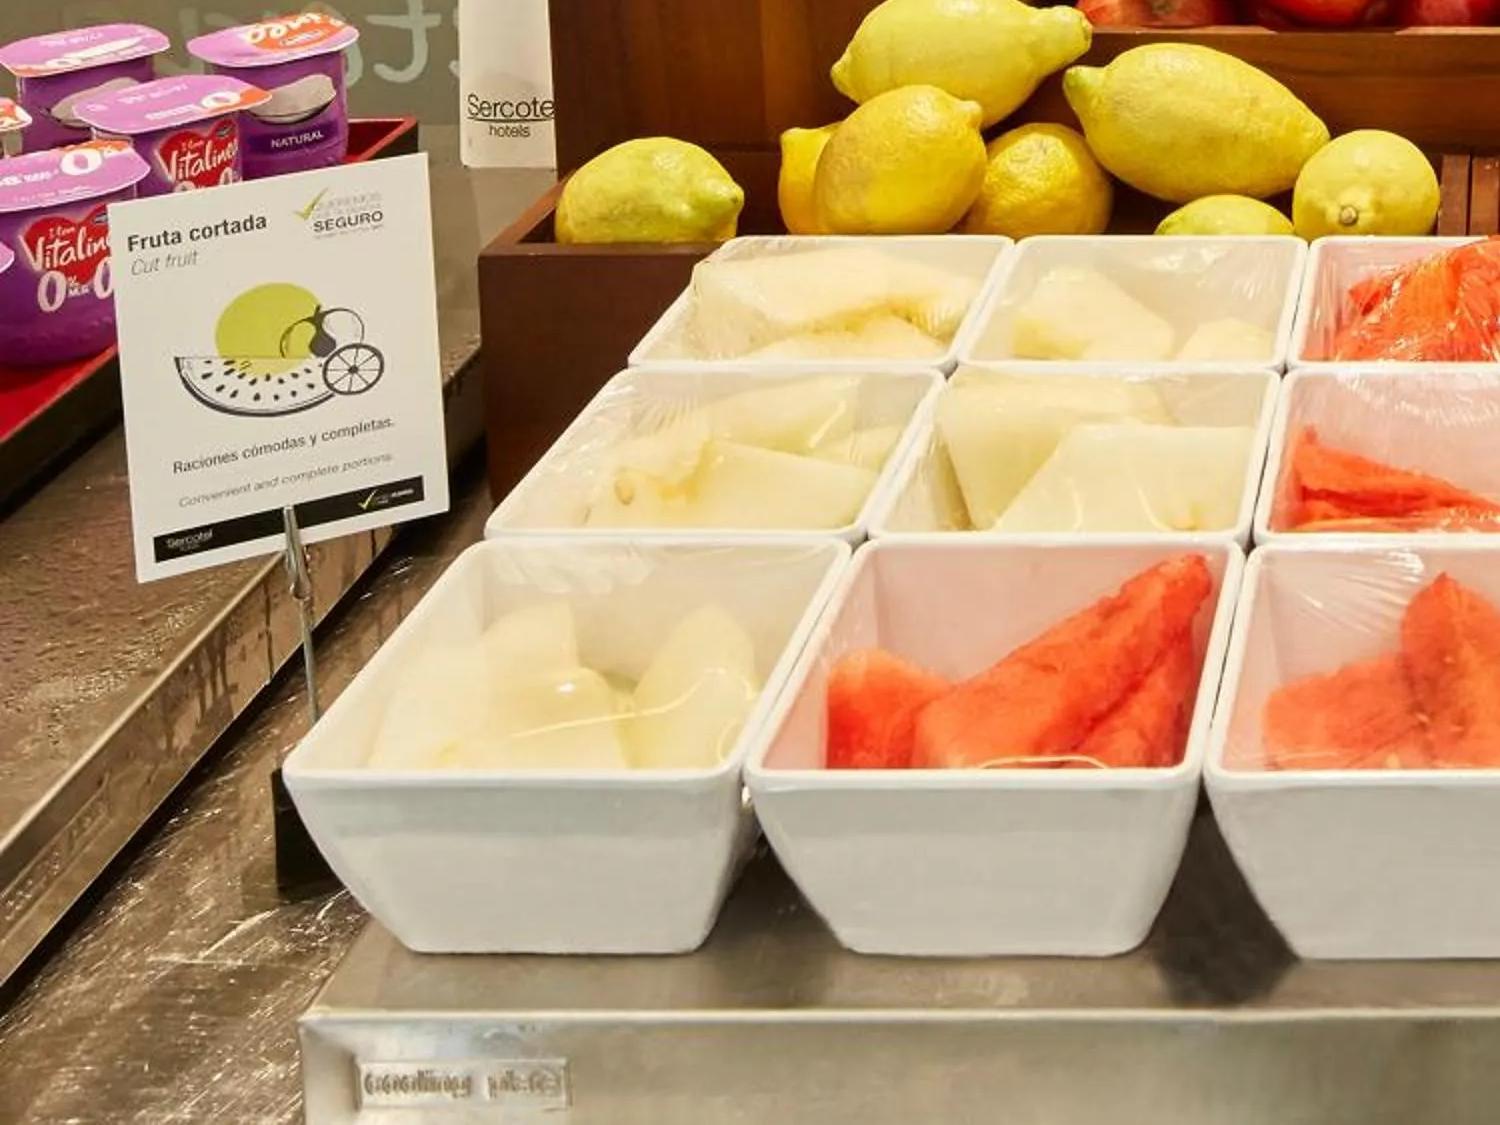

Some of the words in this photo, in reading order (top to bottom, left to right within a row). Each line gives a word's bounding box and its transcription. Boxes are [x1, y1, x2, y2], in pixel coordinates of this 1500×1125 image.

[271, 130, 324, 148] NATURAL
[489, 125, 530, 138] hotels
[127, 229, 182, 252] Fruta
[189, 214, 267, 242] cortada
[313, 210, 383, 232] SEGURO
[131, 256, 160, 276] Cut
[165, 250, 198, 269] fruit
[173, 451, 239, 475] Raciones
[242, 435, 305, 460] cómodas
[310, 433, 318, 447] y
[253, 476, 280, 492] and
[281, 464, 339, 487] complete
